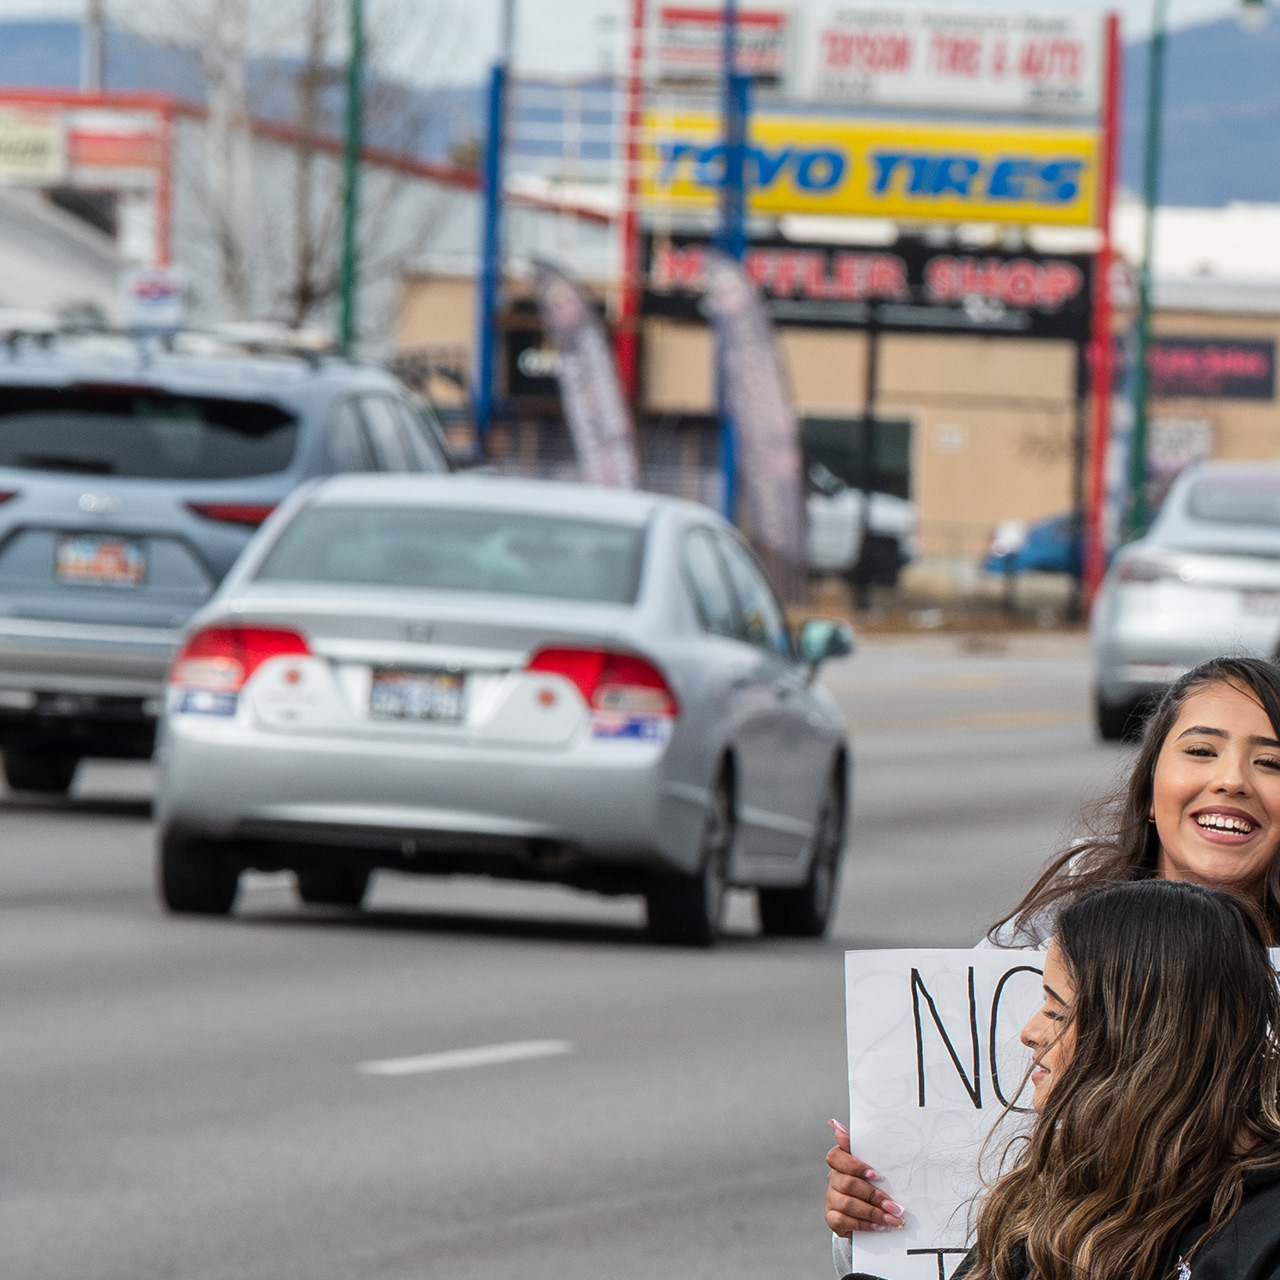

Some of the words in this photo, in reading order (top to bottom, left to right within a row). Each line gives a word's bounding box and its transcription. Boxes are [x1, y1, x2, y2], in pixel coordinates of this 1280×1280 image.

[659, 143, 847, 193] TOYO
[870, 150, 1086, 202] TIRES
[665, 248, 907, 302] MFFLER
[924, 257, 1084, 307] SHOP
